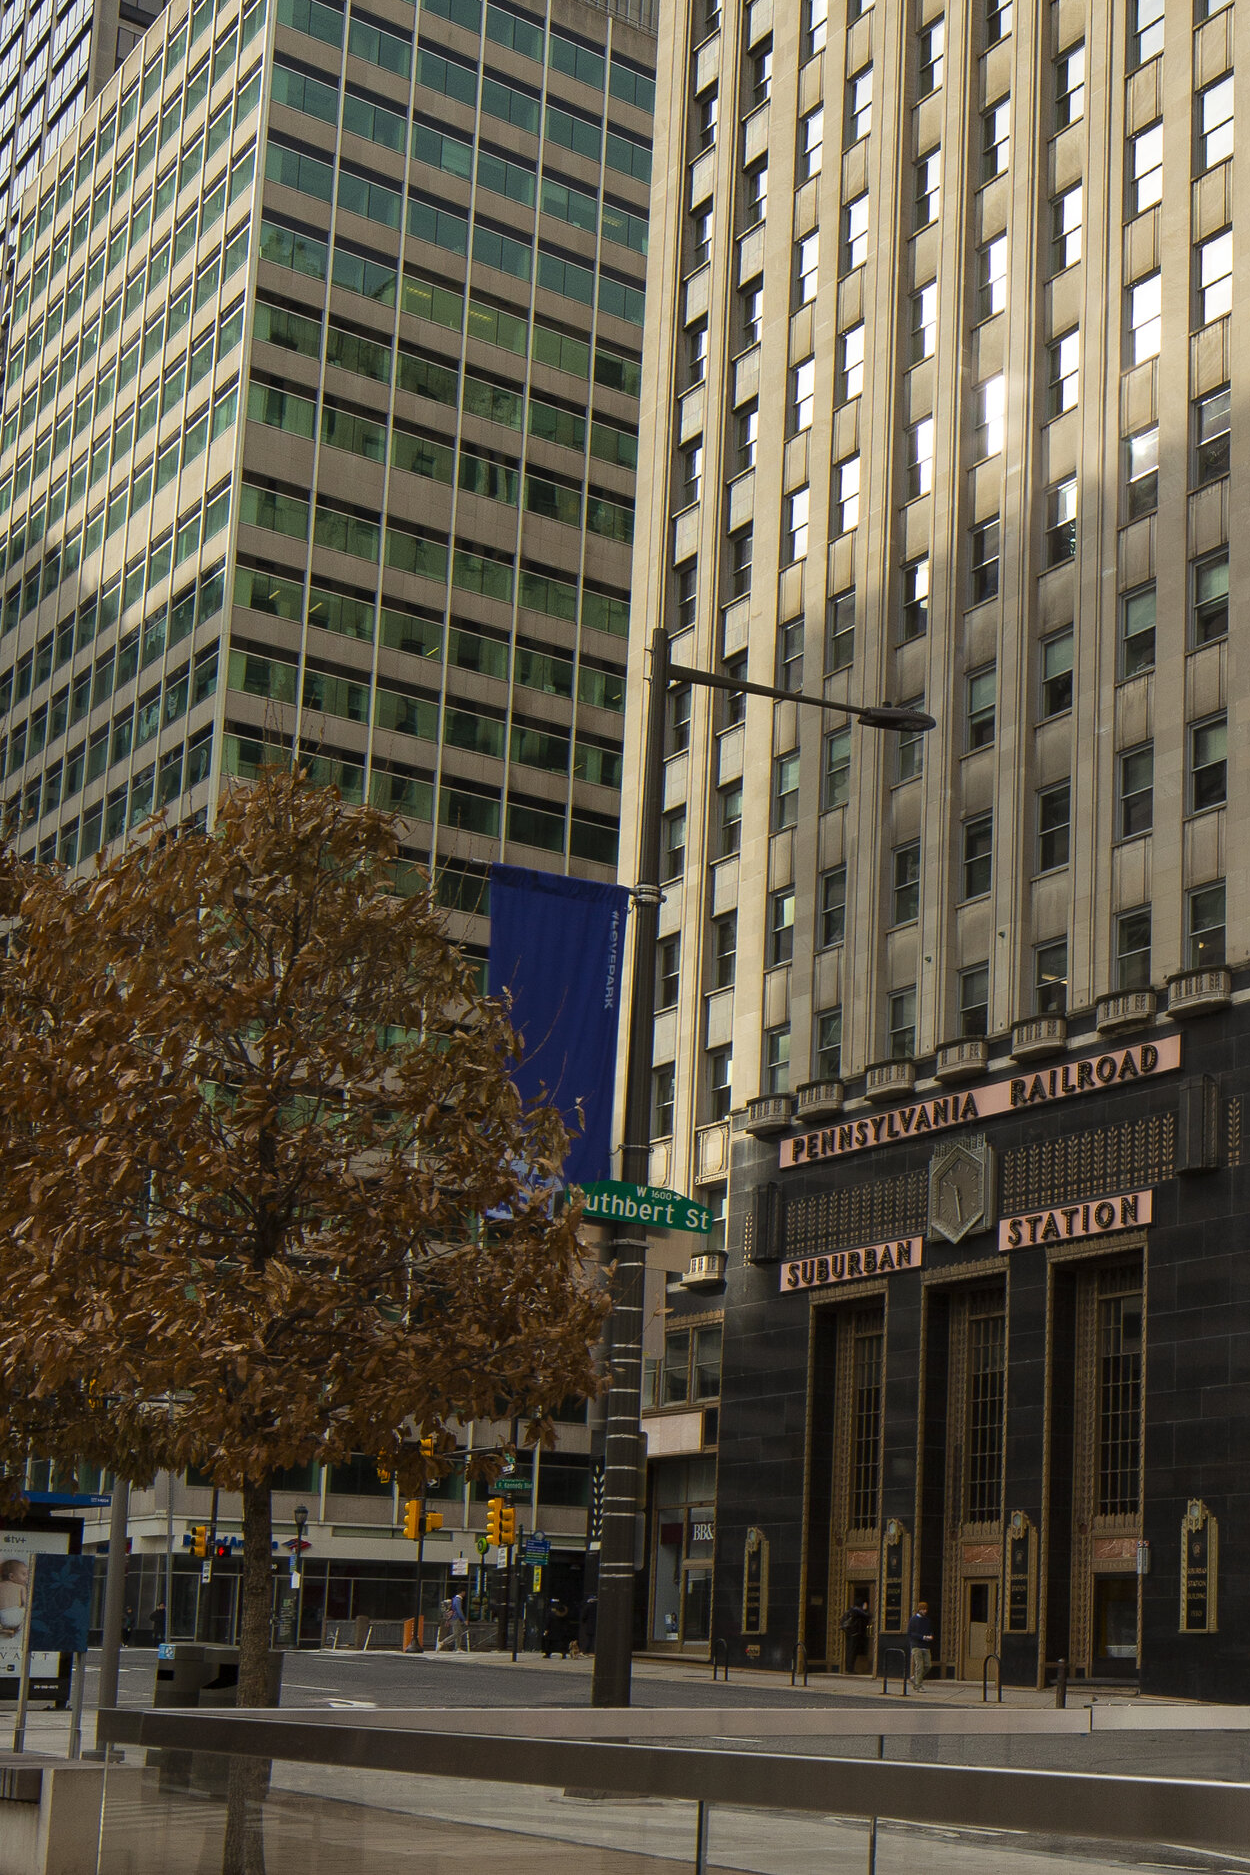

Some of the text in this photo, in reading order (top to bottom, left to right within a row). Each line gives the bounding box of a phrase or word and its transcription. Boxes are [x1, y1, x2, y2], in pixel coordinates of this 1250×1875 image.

[791, 1044, 1159, 1163] PENNSYLVANIA RAILROAD
[569, 1192, 709, 1230] uthbert St
[637, 1186, 672, 1201] W 1600
[1008, 1195, 1138, 1246] STATION
[787, 1240, 912, 1287] SUBURBAN
